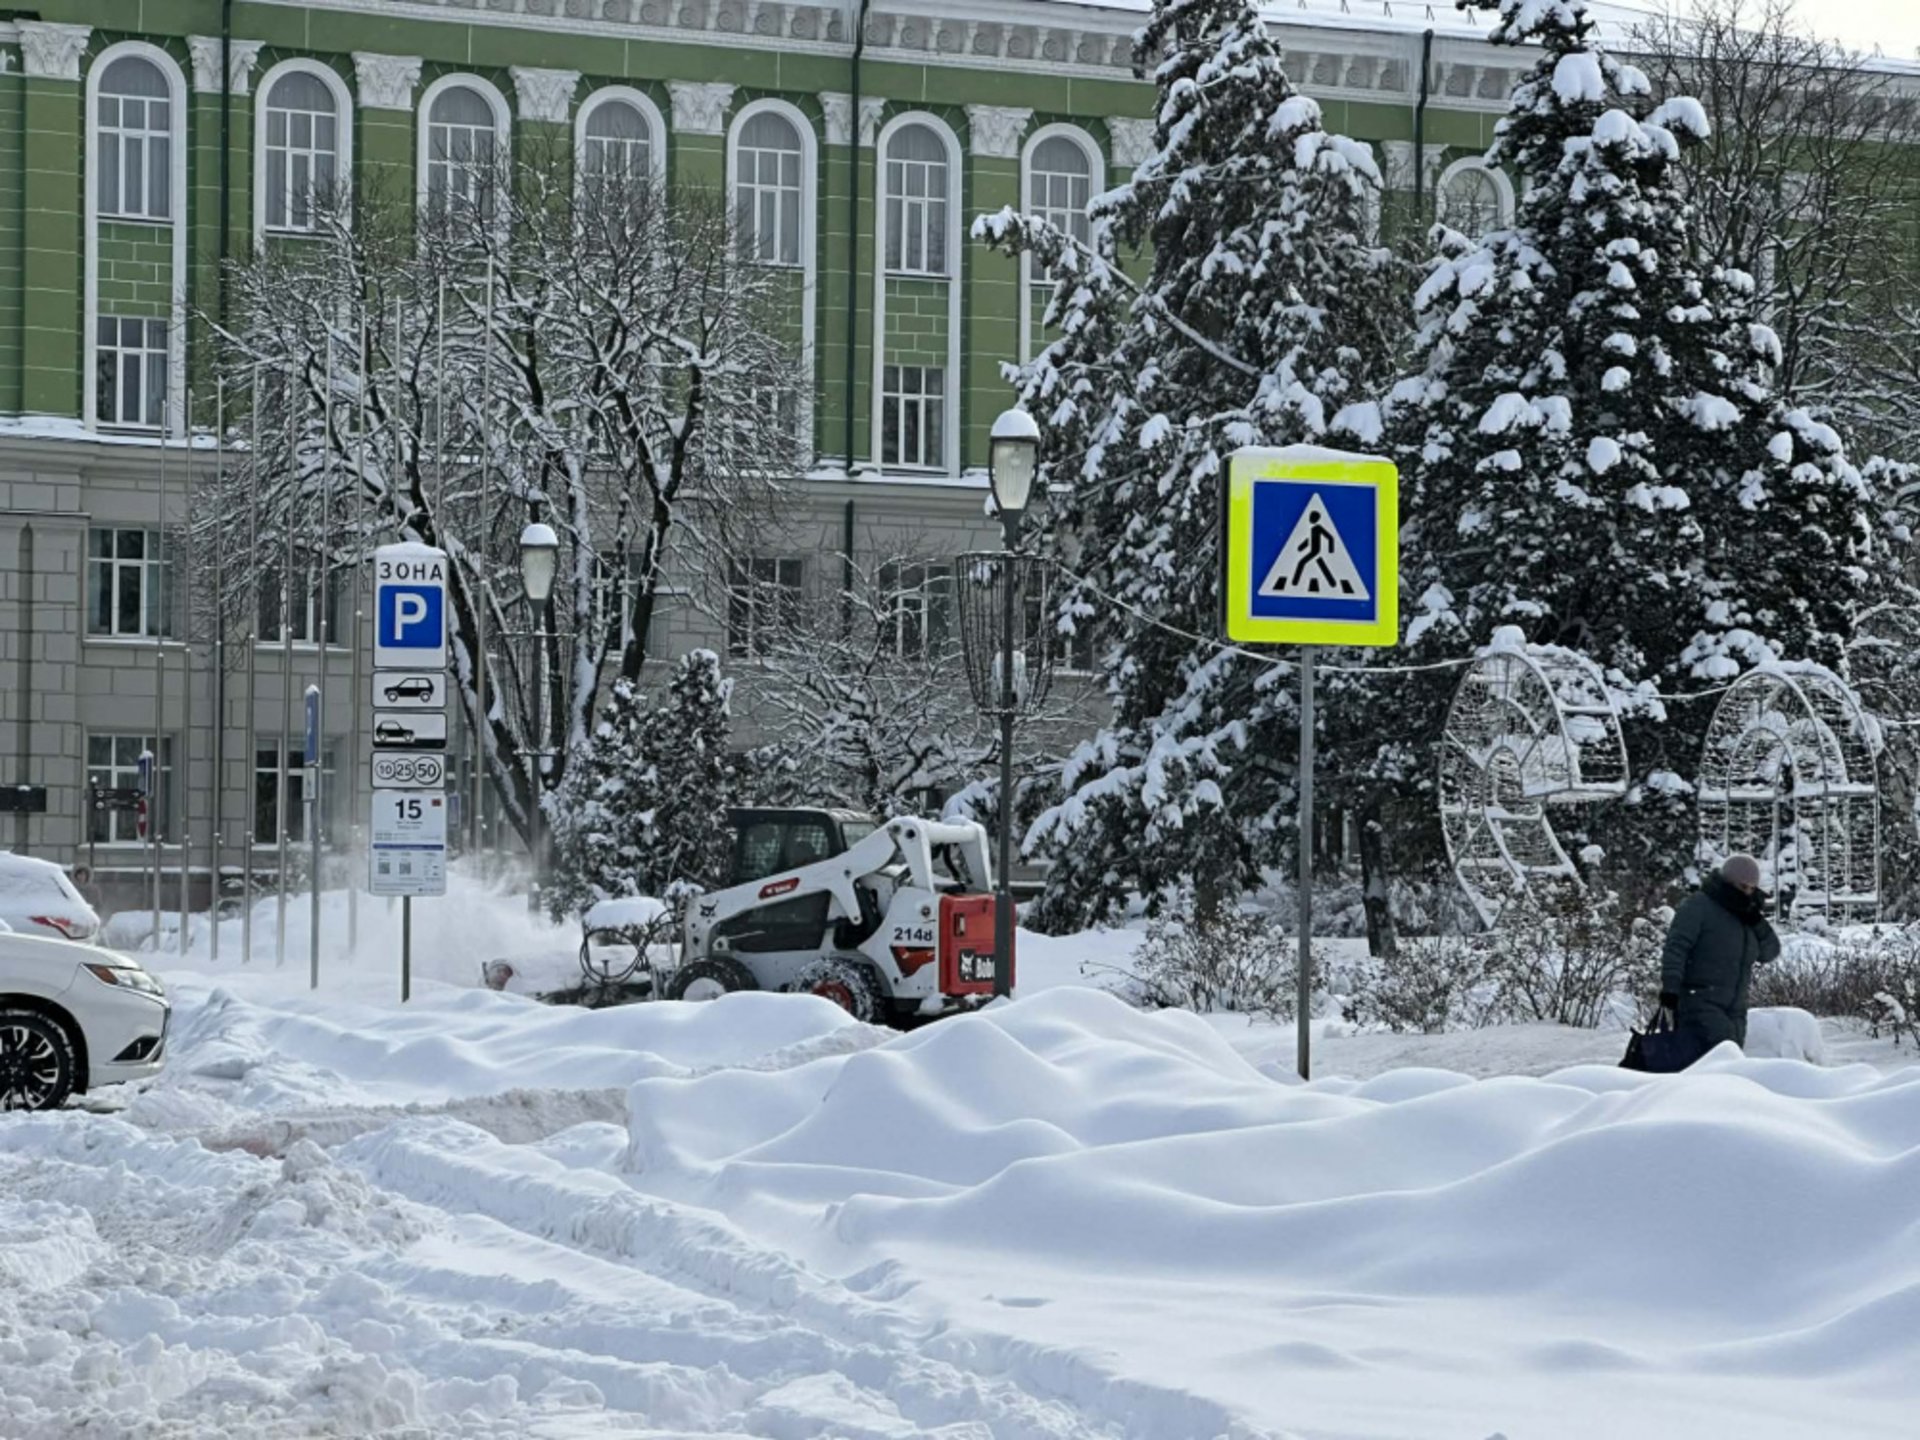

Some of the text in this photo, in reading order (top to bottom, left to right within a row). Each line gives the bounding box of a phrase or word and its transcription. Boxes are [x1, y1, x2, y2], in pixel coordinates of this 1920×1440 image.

[379, 562, 443, 581] ЗОНА
[394, 592, 427, 640] P
[380, 763, 437, 778] 10 25 50
[395, 798, 423, 820] 15
